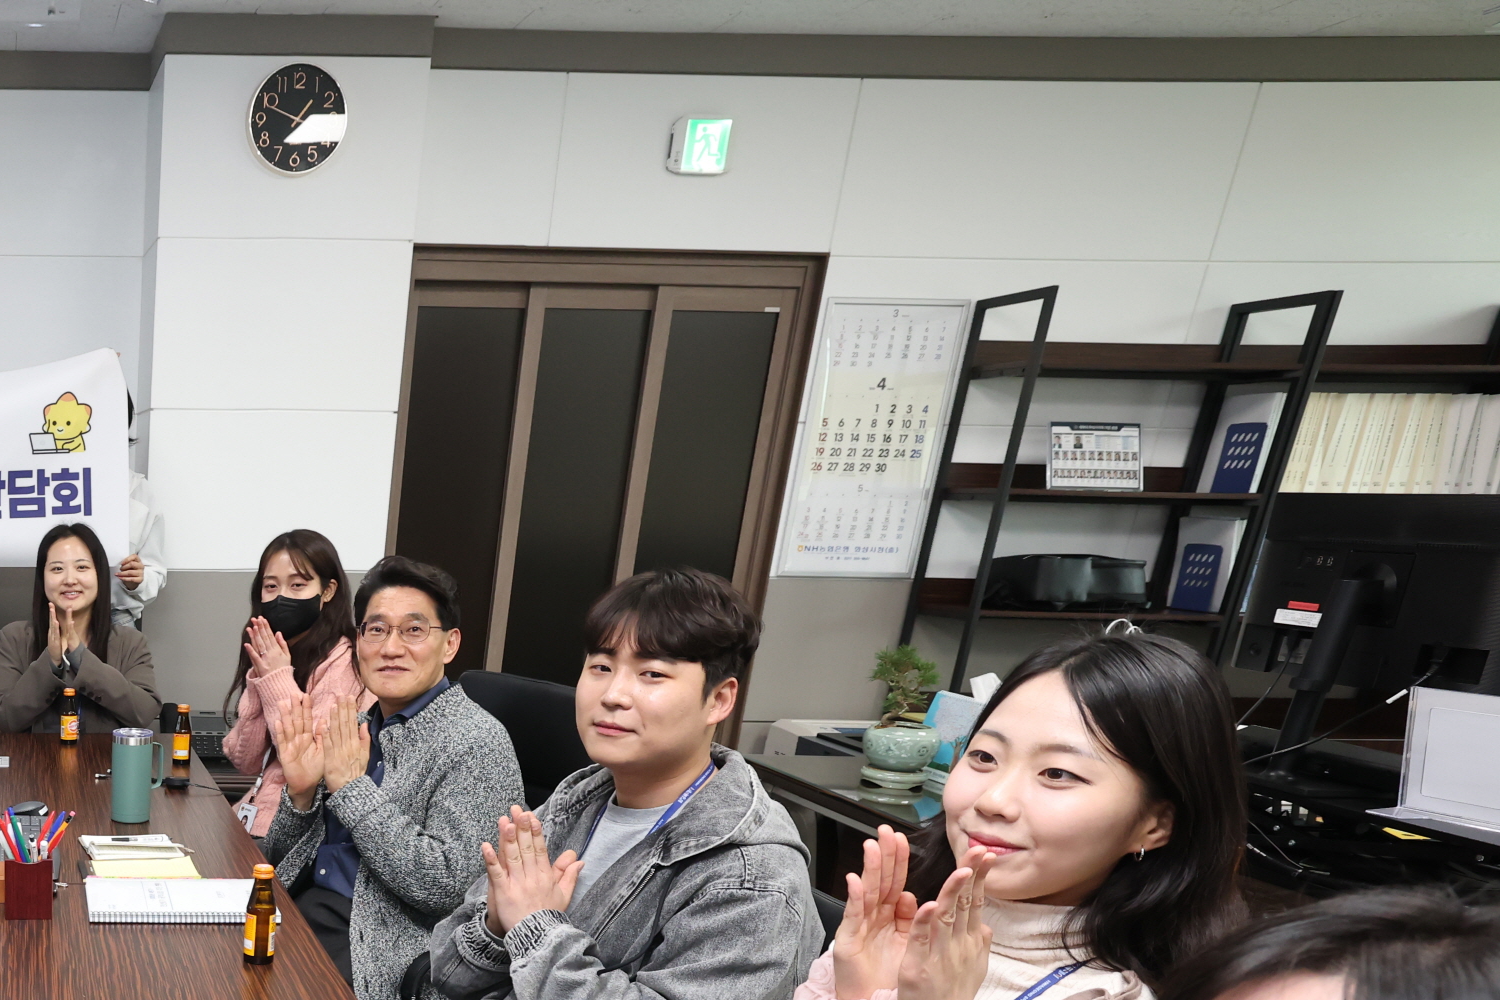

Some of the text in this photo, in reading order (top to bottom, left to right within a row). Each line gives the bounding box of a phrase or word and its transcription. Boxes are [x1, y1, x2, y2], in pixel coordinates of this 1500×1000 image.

[278, 76, 288, 93] 11
[293, 72, 307, 89] 12
[263, 92, 279, 109] 10
[323, 91, 335, 108] 2
[255, 111, 267, 128] 9
[259, 131, 270, 147] 8
[273, 145, 283, 162] 7
[289, 151, 300, 167] 6
[307, 145, 318, 162] 5
[893, 309, 899, 318] 3
[876, 377, 887, 391] 4
[890, 404, 897, 414] 2
[906, 405, 913, 414] 3
[922, 405, 929, 414] 4
[822, 418, 926, 429] 5 6 7 8 9 10 11
[818, 433, 924, 444] 12 13 14 15 16 17 18
[815, 447, 922, 459] 19 20 21 22 23 24 25
[810, 462, 887, 472] 26 27 28 29 30
